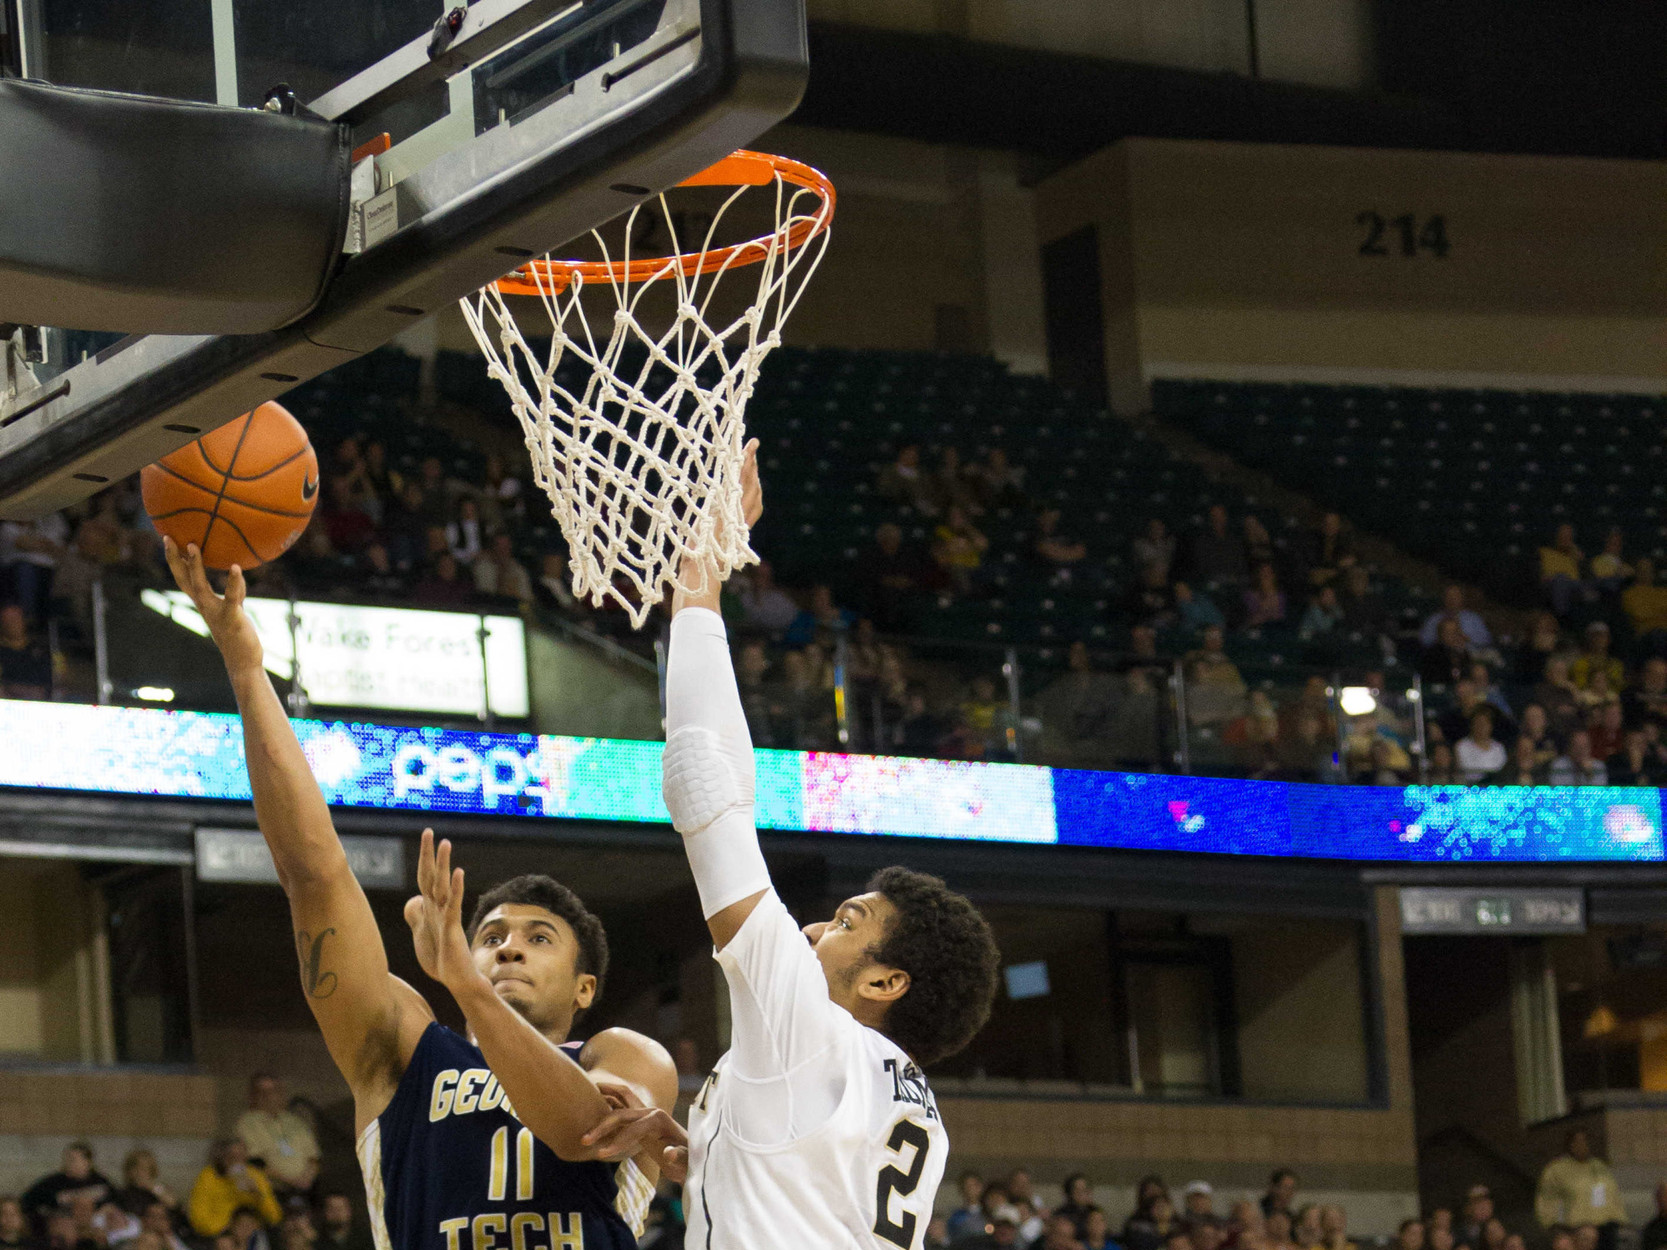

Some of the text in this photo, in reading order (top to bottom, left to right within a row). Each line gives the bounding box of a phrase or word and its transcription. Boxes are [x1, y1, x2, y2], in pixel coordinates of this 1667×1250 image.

[1354, 210, 1452, 257] 214
[385, 620, 472, 658] Fores
[488, 1125, 534, 1201] 11
